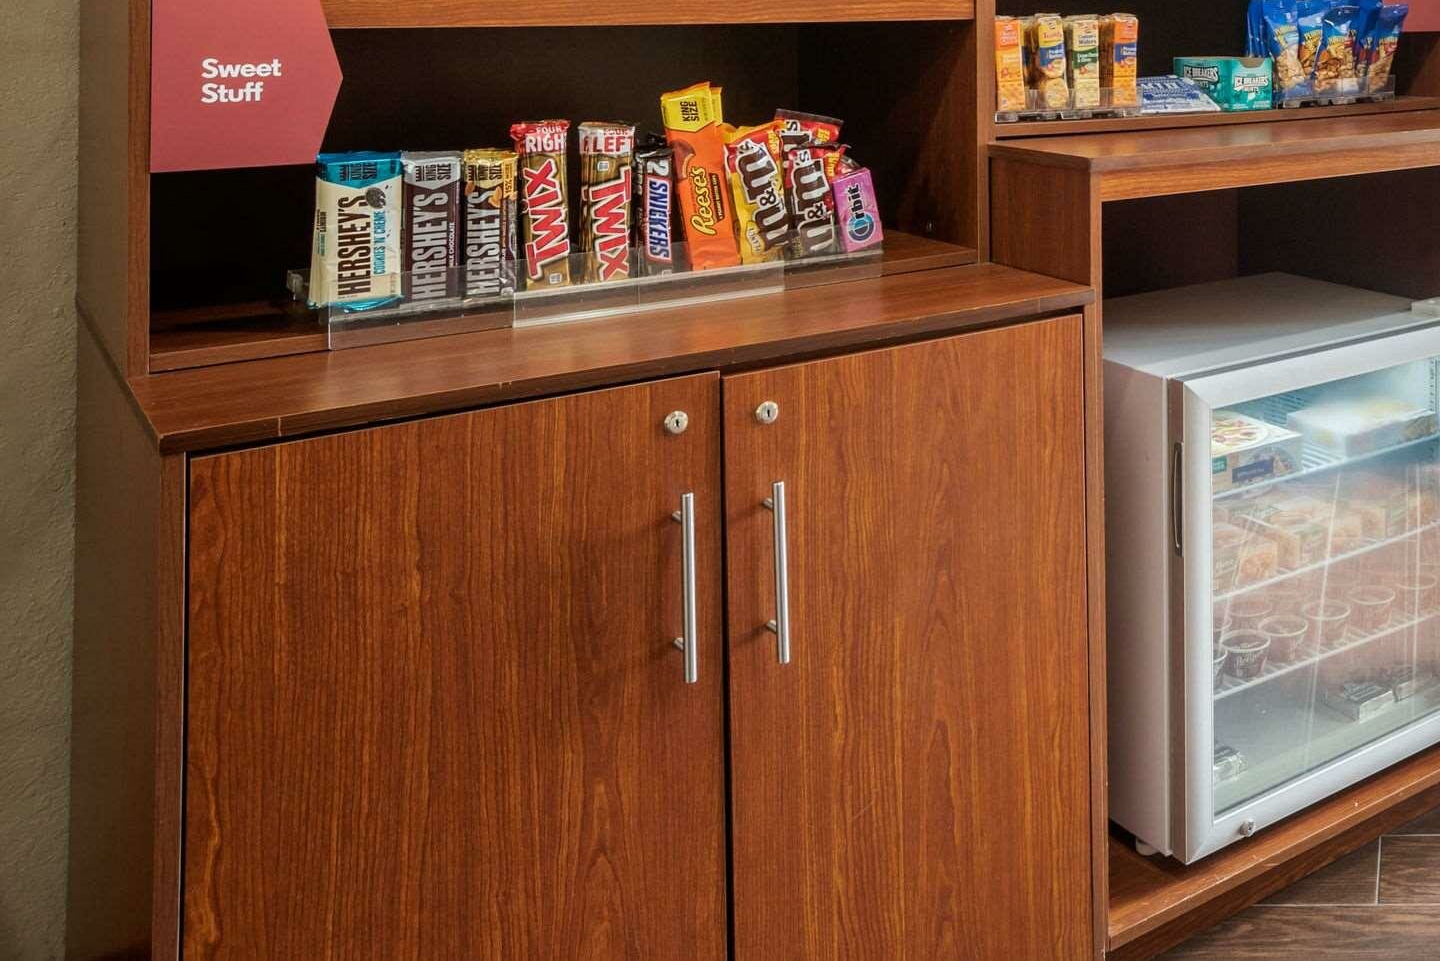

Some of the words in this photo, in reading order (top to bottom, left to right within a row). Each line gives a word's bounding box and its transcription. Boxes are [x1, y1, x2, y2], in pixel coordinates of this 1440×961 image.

[201, 58, 282, 79] Sweet
[201, 81, 263, 103] Stuff
[680, 101, 690, 122] KING
[688, 101, 700, 122] SIZE
[536, 125, 562, 134] FOUR
[525, 133, 567, 153] RIGH
[363, 161, 377, 179] SIZE
[425, 165, 436, 181] KING
[438, 163, 451, 180] SIZE
[489, 164, 502, 180] SIZE
[647, 160, 669, 177] 2
[691, 166, 717, 235] Reese's
[523, 158, 570, 279] TWIX
[589, 166, 632, 281] TWIX
[648, 179, 670, 259] SNICKERS
[847, 184, 875, 242] Orbit
[338, 195, 371, 296] HERSHEY'S
[412, 192, 449, 300] HERSHEY'S
[466, 191, 500, 295] HERSHEY'S
[373, 246, 386, 275] COOKIES
